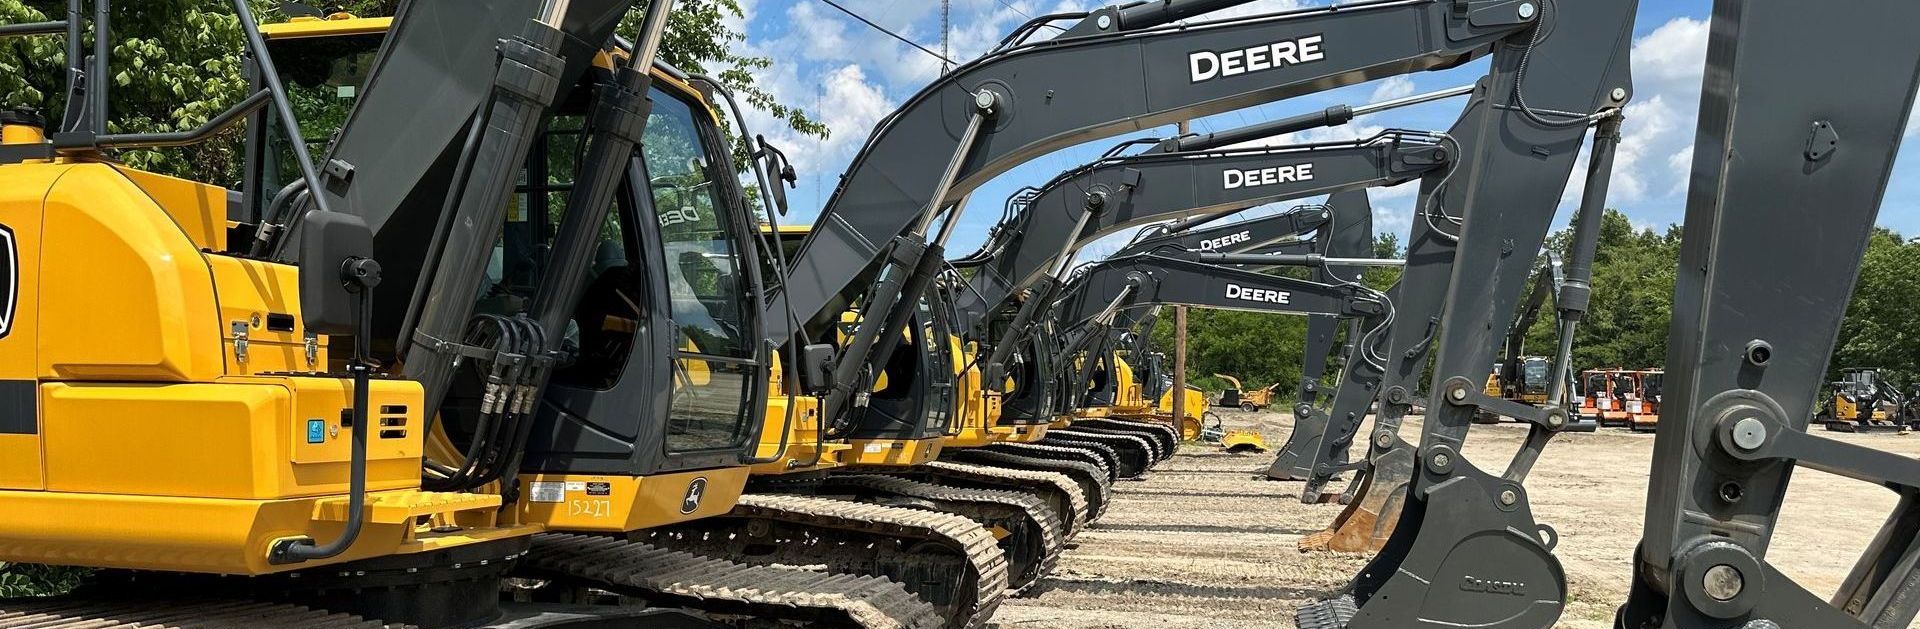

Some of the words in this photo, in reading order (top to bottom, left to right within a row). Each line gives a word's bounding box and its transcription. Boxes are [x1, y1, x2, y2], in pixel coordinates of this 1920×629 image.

[1189, 35, 1324, 82] DEERE
[1223, 163, 1313, 190] DEERE
[1200, 230, 1251, 250] DEERE
[1225, 283, 1291, 304] DEERE
